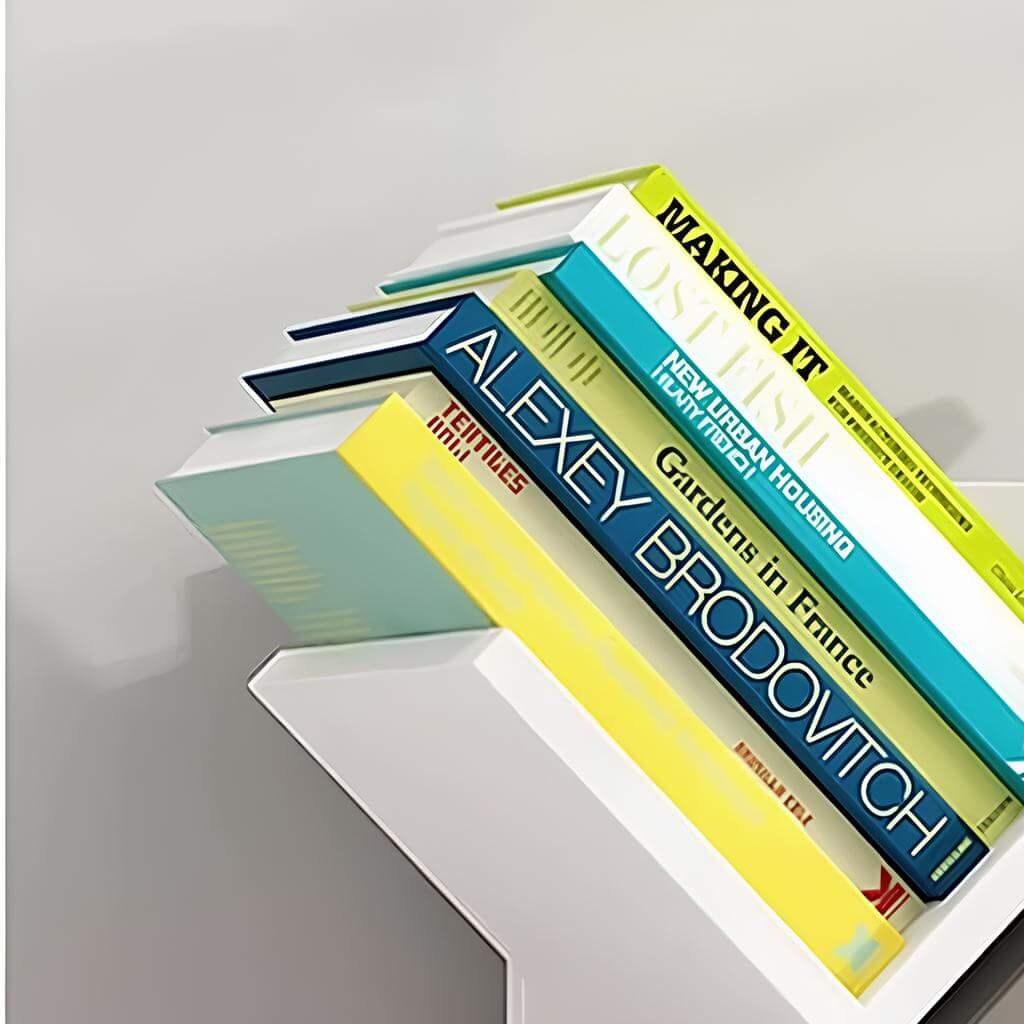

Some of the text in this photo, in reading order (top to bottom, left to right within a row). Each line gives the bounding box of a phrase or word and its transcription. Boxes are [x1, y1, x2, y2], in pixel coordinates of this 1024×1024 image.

[597, 214, 728, 344] LOST
[656, 198, 789, 343] MAKING
[782, 336, 828, 381] IT
[662, 349, 713, 400] NEW
[445, 330, 651, 521] ALEXEY
[635, 519, 947, 855] BRODOVITCH
[656, 447, 758, 563] Gardens
[757, 556, 787, 595] in
